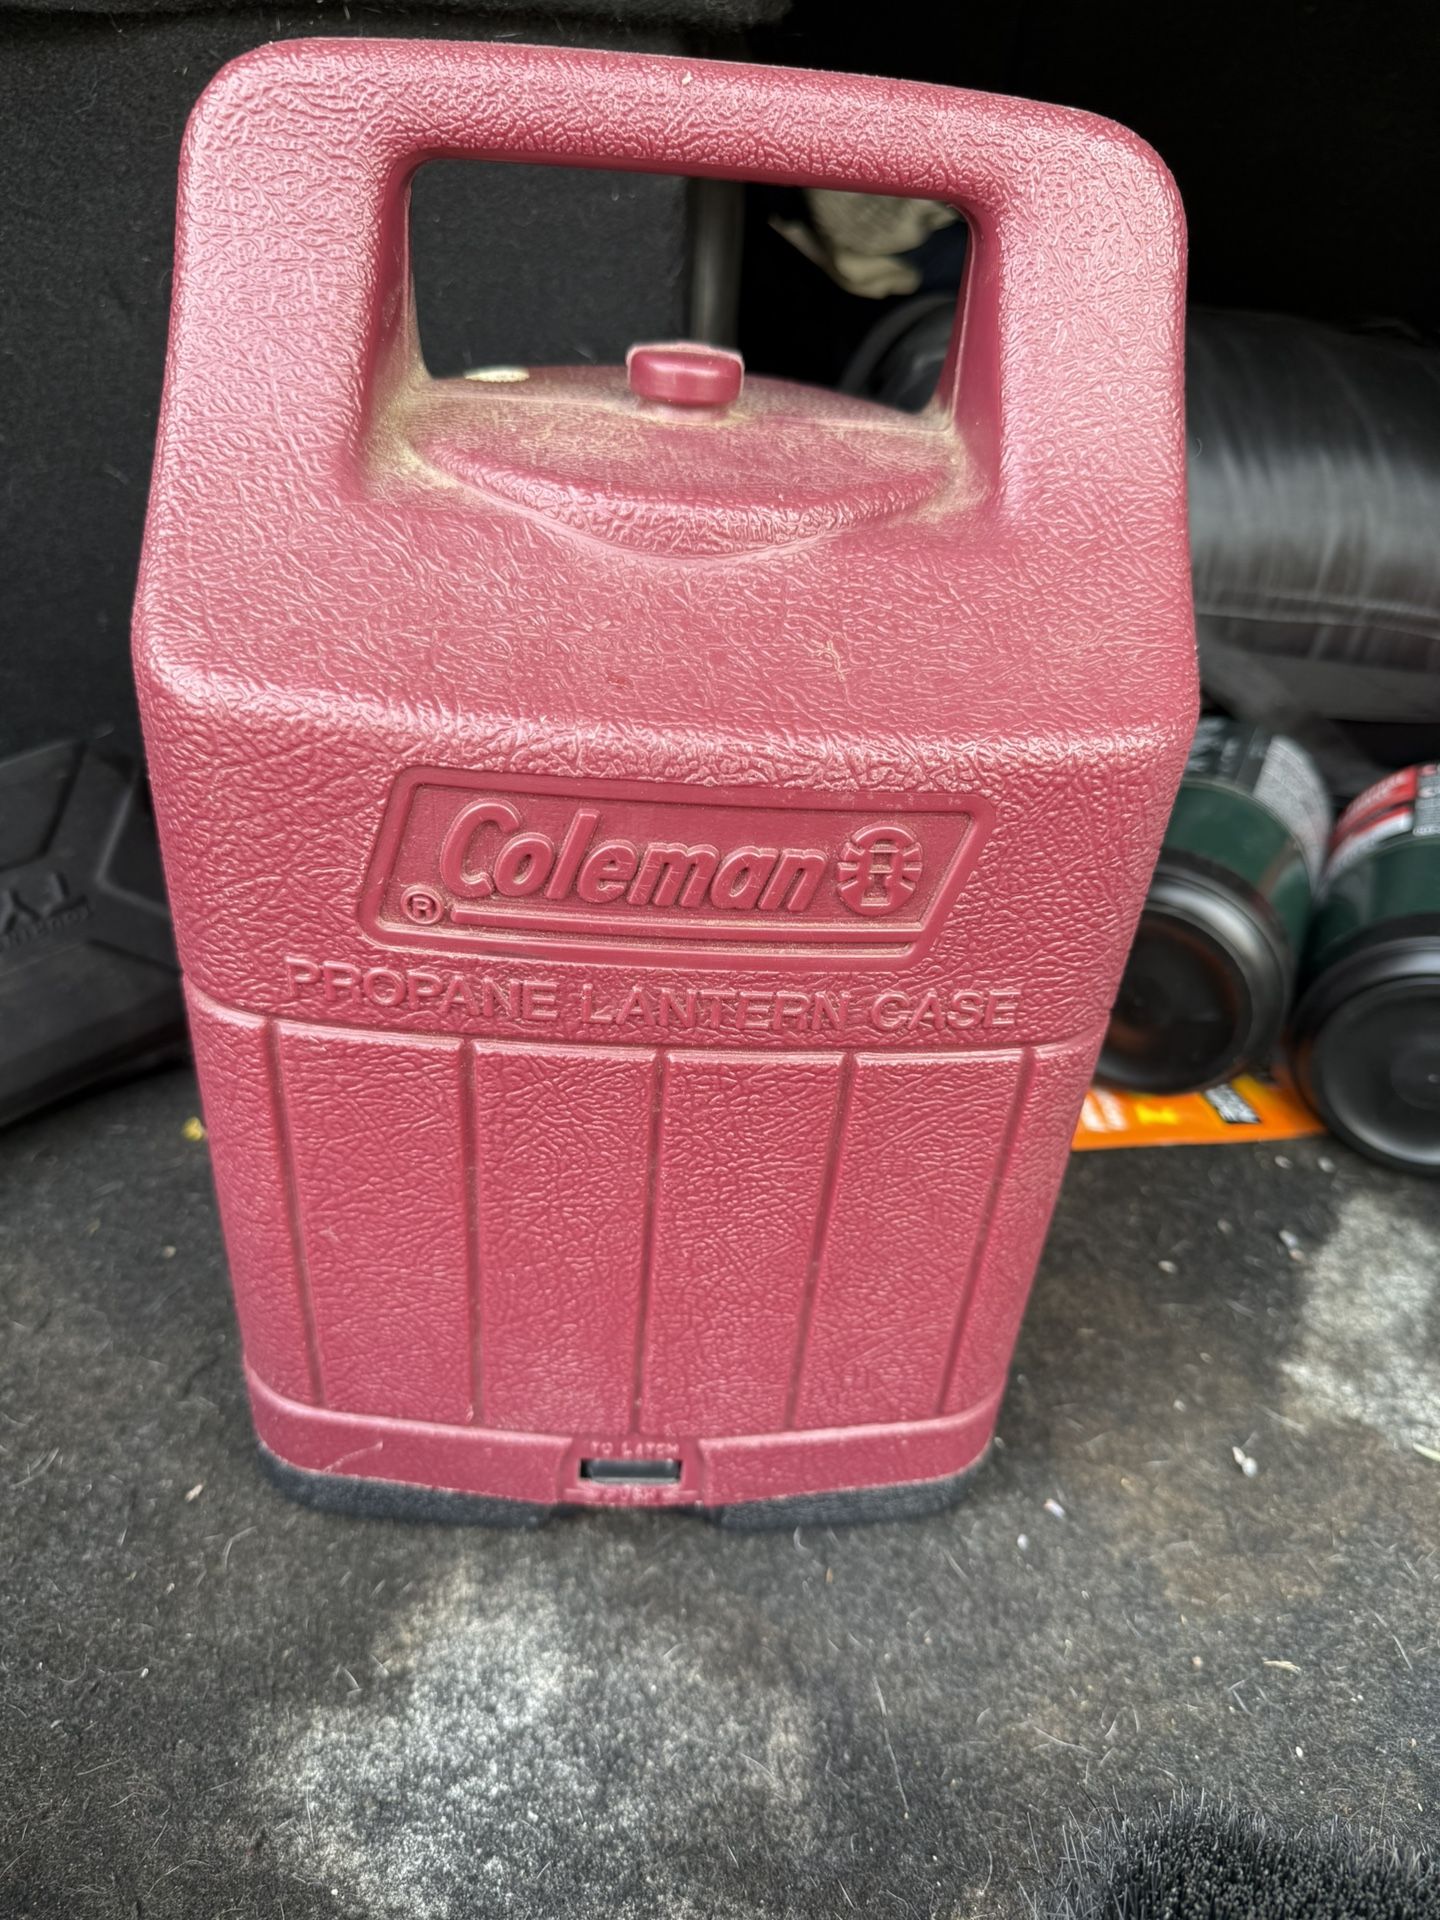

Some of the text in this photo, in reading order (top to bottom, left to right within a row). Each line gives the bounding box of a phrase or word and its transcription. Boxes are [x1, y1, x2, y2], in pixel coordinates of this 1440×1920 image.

[440, 799, 828, 912] Coleman
[284, 955, 1021, 1031] PROPANE LANTERN CASE
